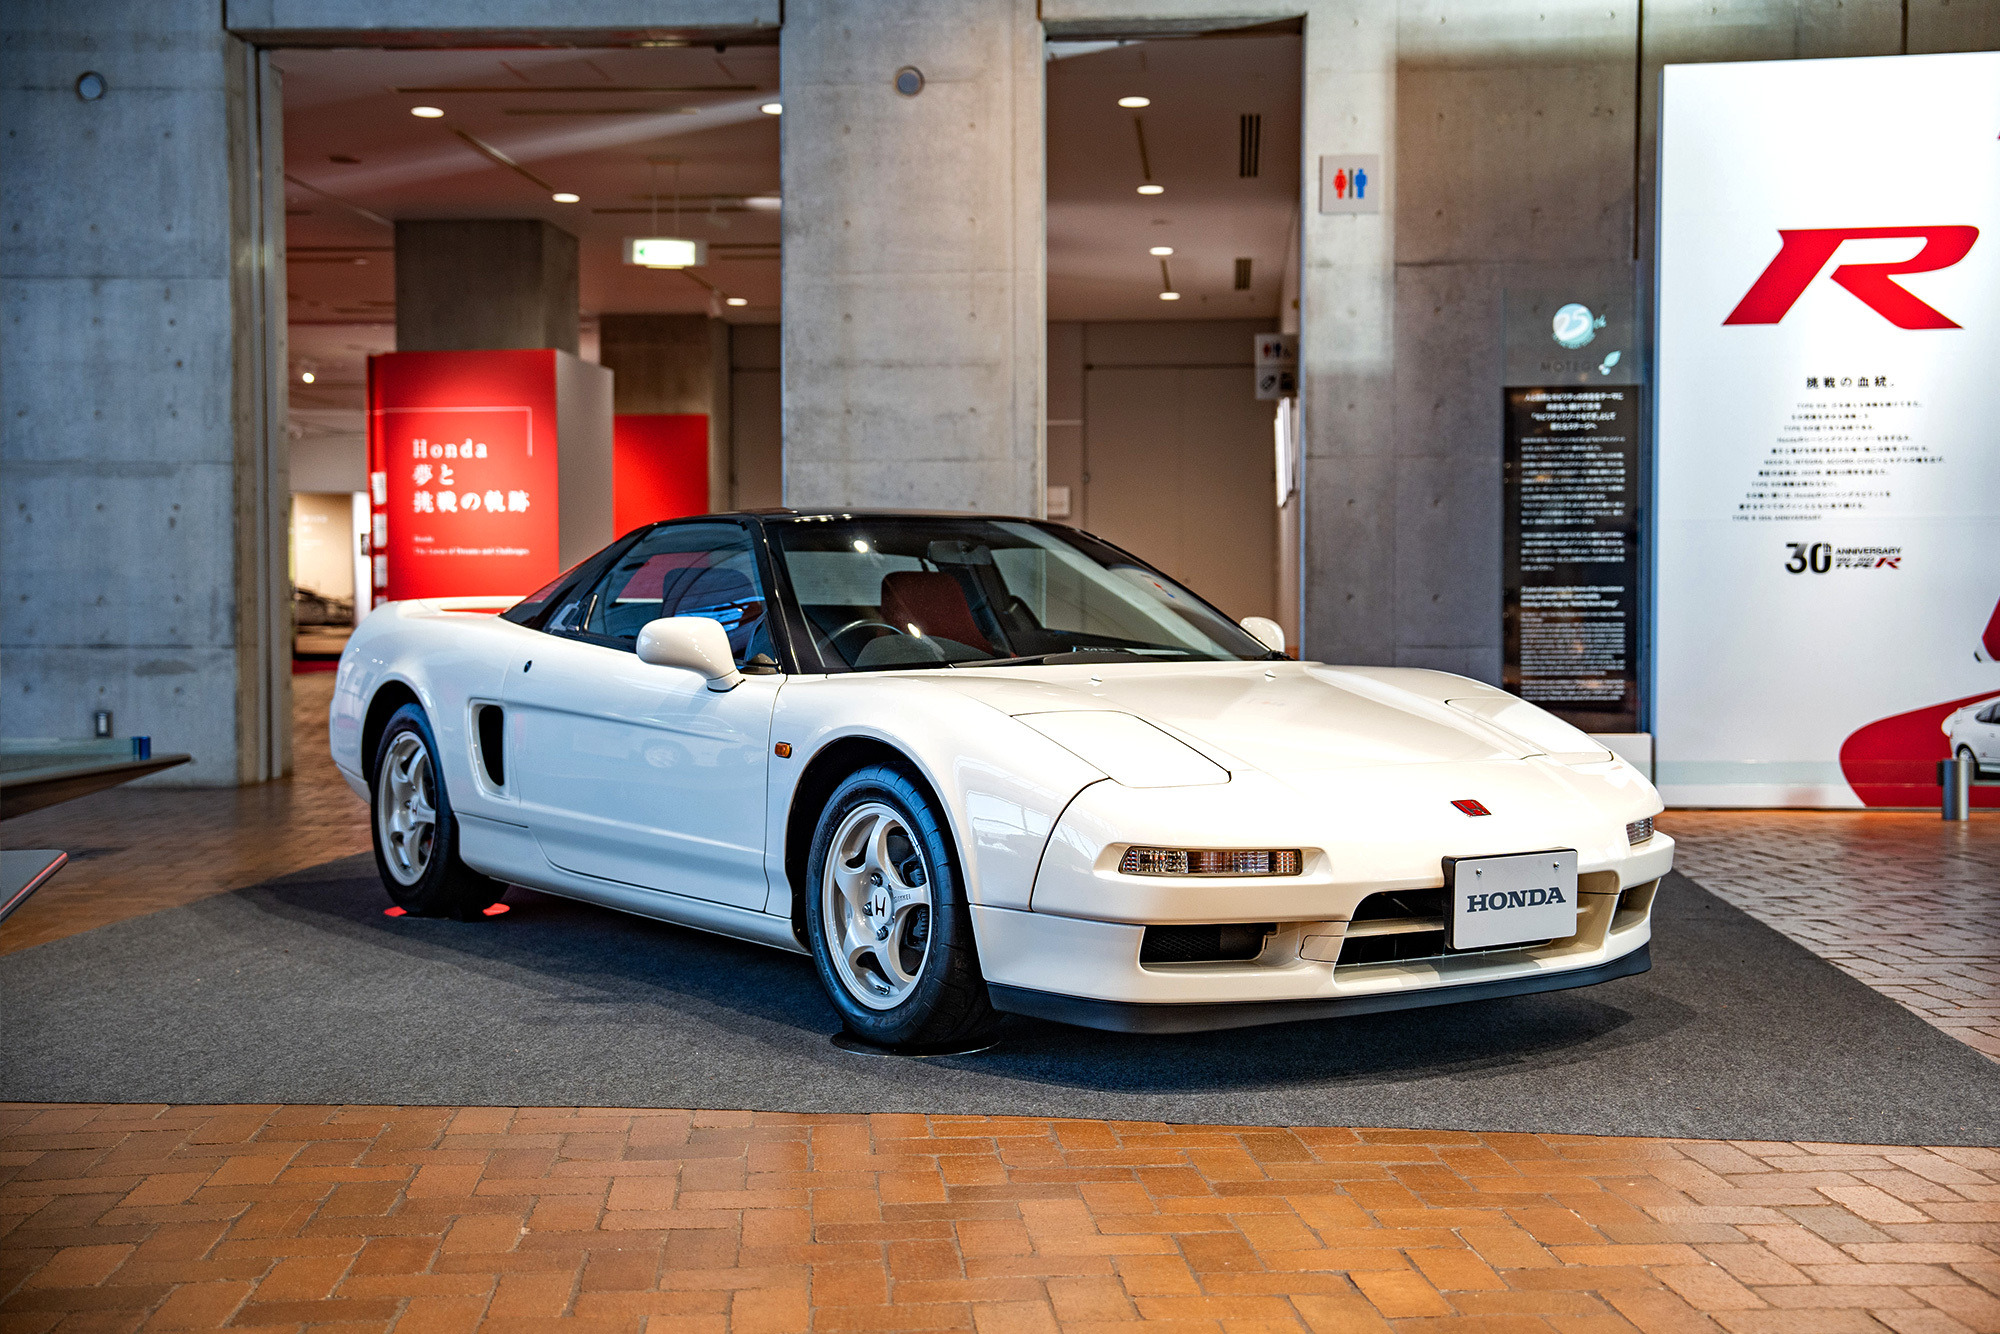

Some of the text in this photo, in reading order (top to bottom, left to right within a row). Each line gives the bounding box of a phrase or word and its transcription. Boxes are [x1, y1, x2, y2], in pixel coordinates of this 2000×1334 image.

[1721, 224, 1980, 330] R
[413, 438, 488, 459] Honda
[413, 463, 455, 486] 夢と
[413, 490, 531, 513] 挑戦の軌跡
[1835, 547, 1902, 556] ANNIVERSARY
[1466, 887, 1567, 913] HONDA
